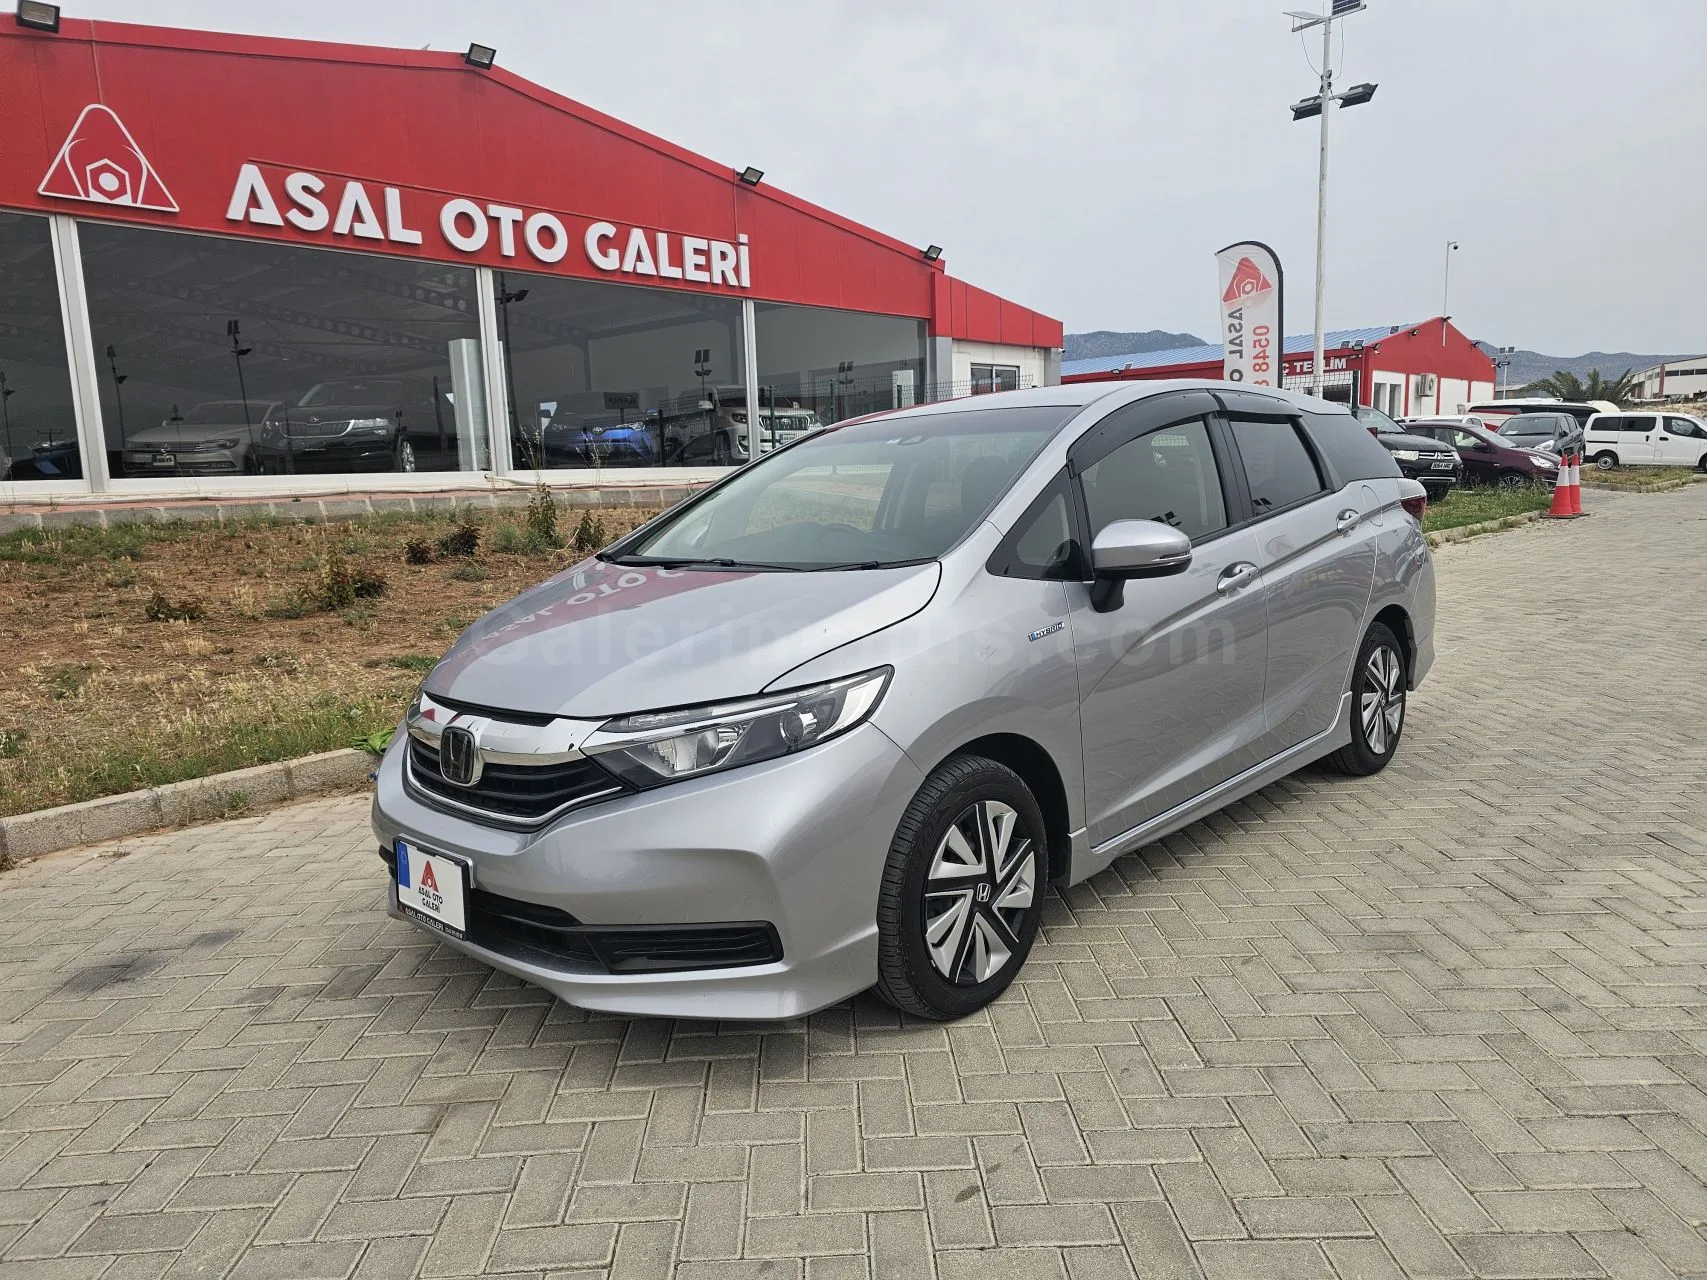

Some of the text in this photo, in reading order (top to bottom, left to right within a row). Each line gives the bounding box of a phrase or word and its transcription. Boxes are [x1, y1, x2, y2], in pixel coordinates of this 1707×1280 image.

[226, 163, 751, 288] ASAL OTO GALERİ
[1293, 356, 1347, 373] TELİM
[1034, 621, 1065, 640] HYBRID
[418, 886, 443, 905] ASAL OTO
[404, 907, 417, 919] ASAL
[417, 912, 427, 922] OTO
